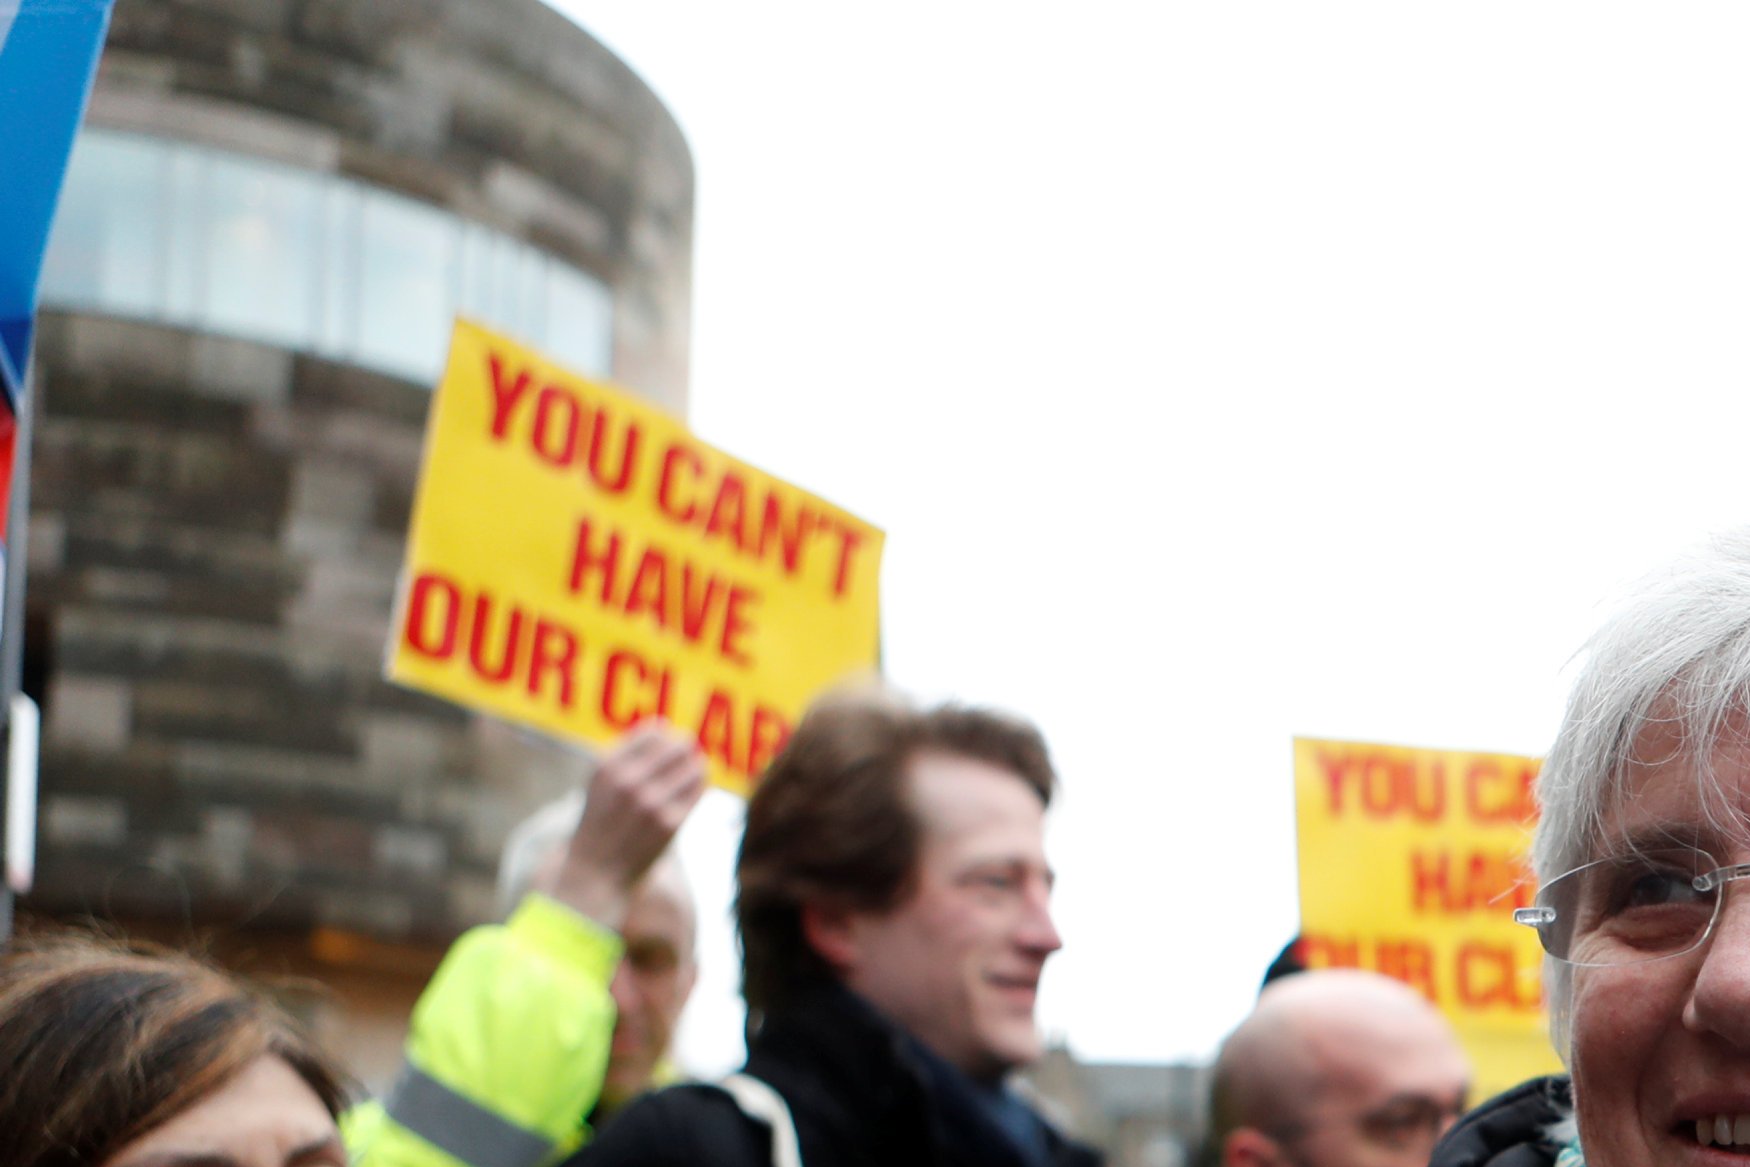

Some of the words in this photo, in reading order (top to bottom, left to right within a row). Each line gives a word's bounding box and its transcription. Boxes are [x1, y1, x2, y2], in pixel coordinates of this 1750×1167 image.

[486, 349, 640, 497] YOU
[656, 442, 864, 600] CAN'T
[567, 516, 760, 668] HAVE
[404, 572, 580, 712] OUR
[600, 648, 792, 778] CLAR
[1316, 751, 1447, 826] YOU
[1464, 759, 1542, 827] CA
[1411, 850, 1540, 914] HAV
[1455, 938, 1546, 1011] CL
